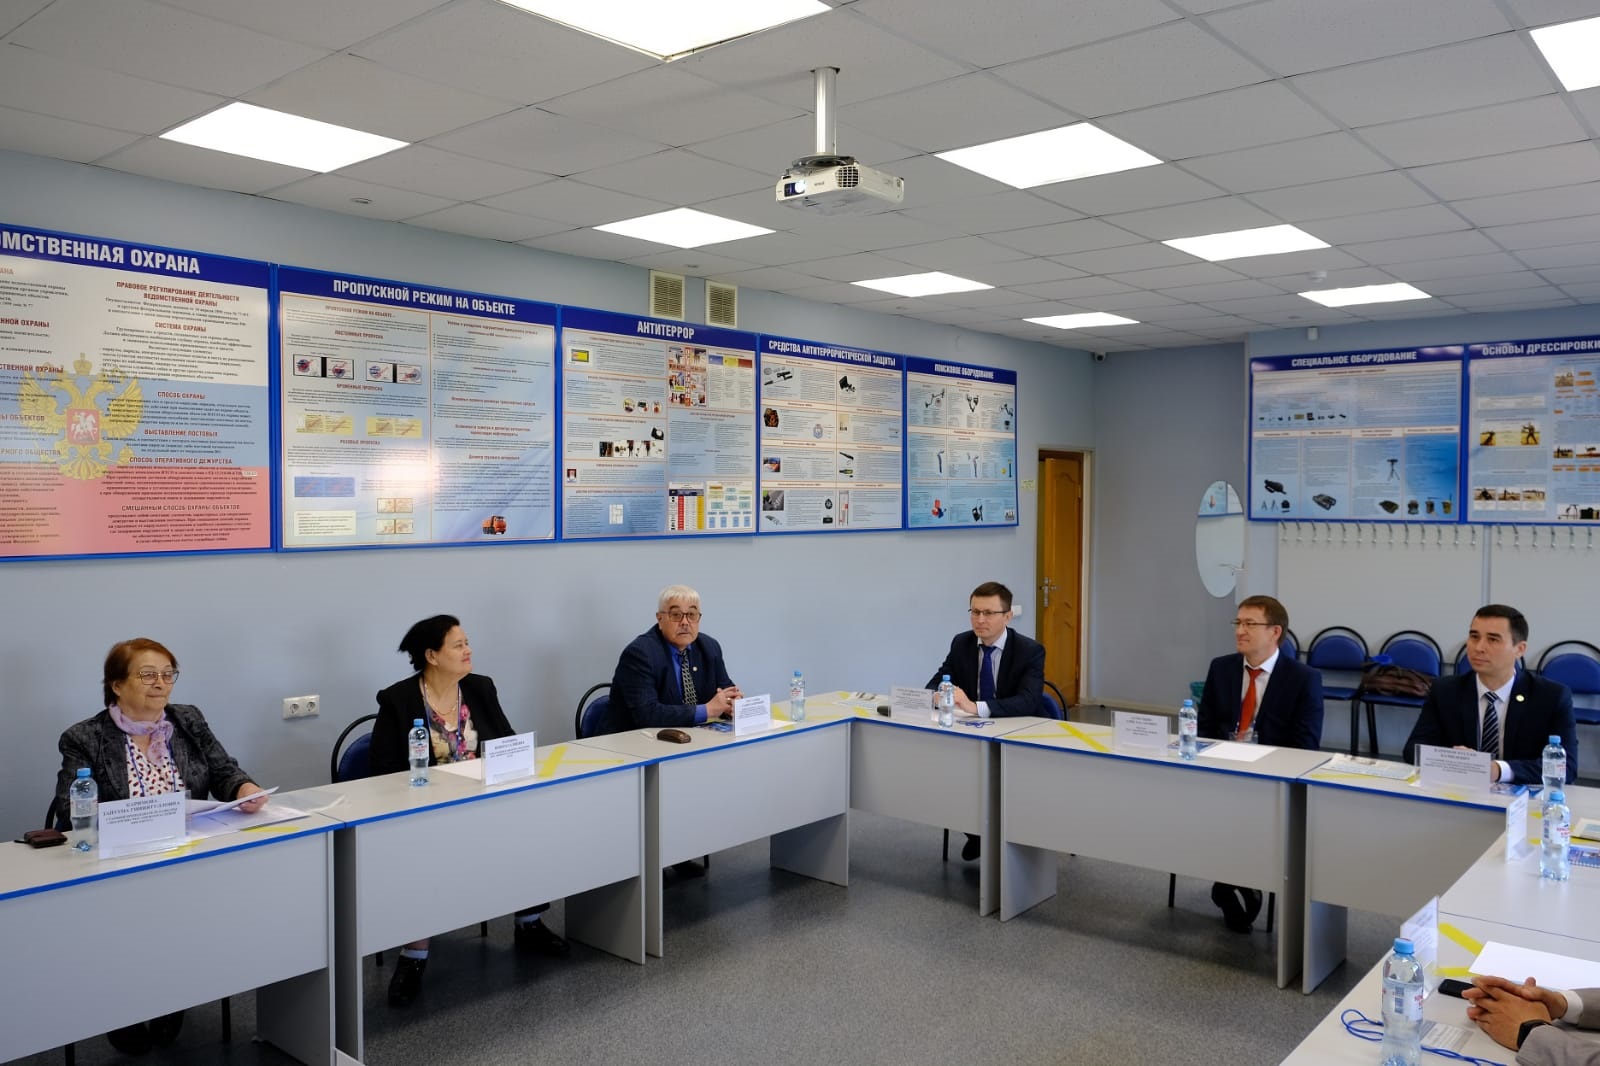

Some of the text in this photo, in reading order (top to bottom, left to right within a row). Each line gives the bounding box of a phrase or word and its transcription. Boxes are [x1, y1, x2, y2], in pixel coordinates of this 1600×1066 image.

[0, 231, 200, 274] МСТВЕННАЯ ОХРАНА
[116, 281, 240, 301] ПРАВОВОЕ РЕГУЛИРОВАНИЕ ДЕЯТЕЛЬНОСТИ
[333, 280, 515, 315] ПРОПУСКНОЙ РЕЖИМ НА ОБЪЕКТЕ
[143, 292, 218, 307] ВЕДОМСТВЕННОЙ ОХРАНЫ
[20, 319, 49, 328] ОХРАНЫ
[154, 321, 207, 332] СИСТЕМА ОХРАНЫ
[637, 321, 695, 339] АНТИТЕРРОР
[768, 340, 896, 366] СРЕДСТВА АНТИТЕРРОРИСТИЧЕСКОЙ ЗАЩИТЫ
[1482, 344, 1524, 356] ОСНОВЫ
[1291, 351, 1417, 367] СПЕЦИАЛЬНОЕ ОБОРУДОВАНИЕ
[157, 391, 181, 399] СПОСОБ
